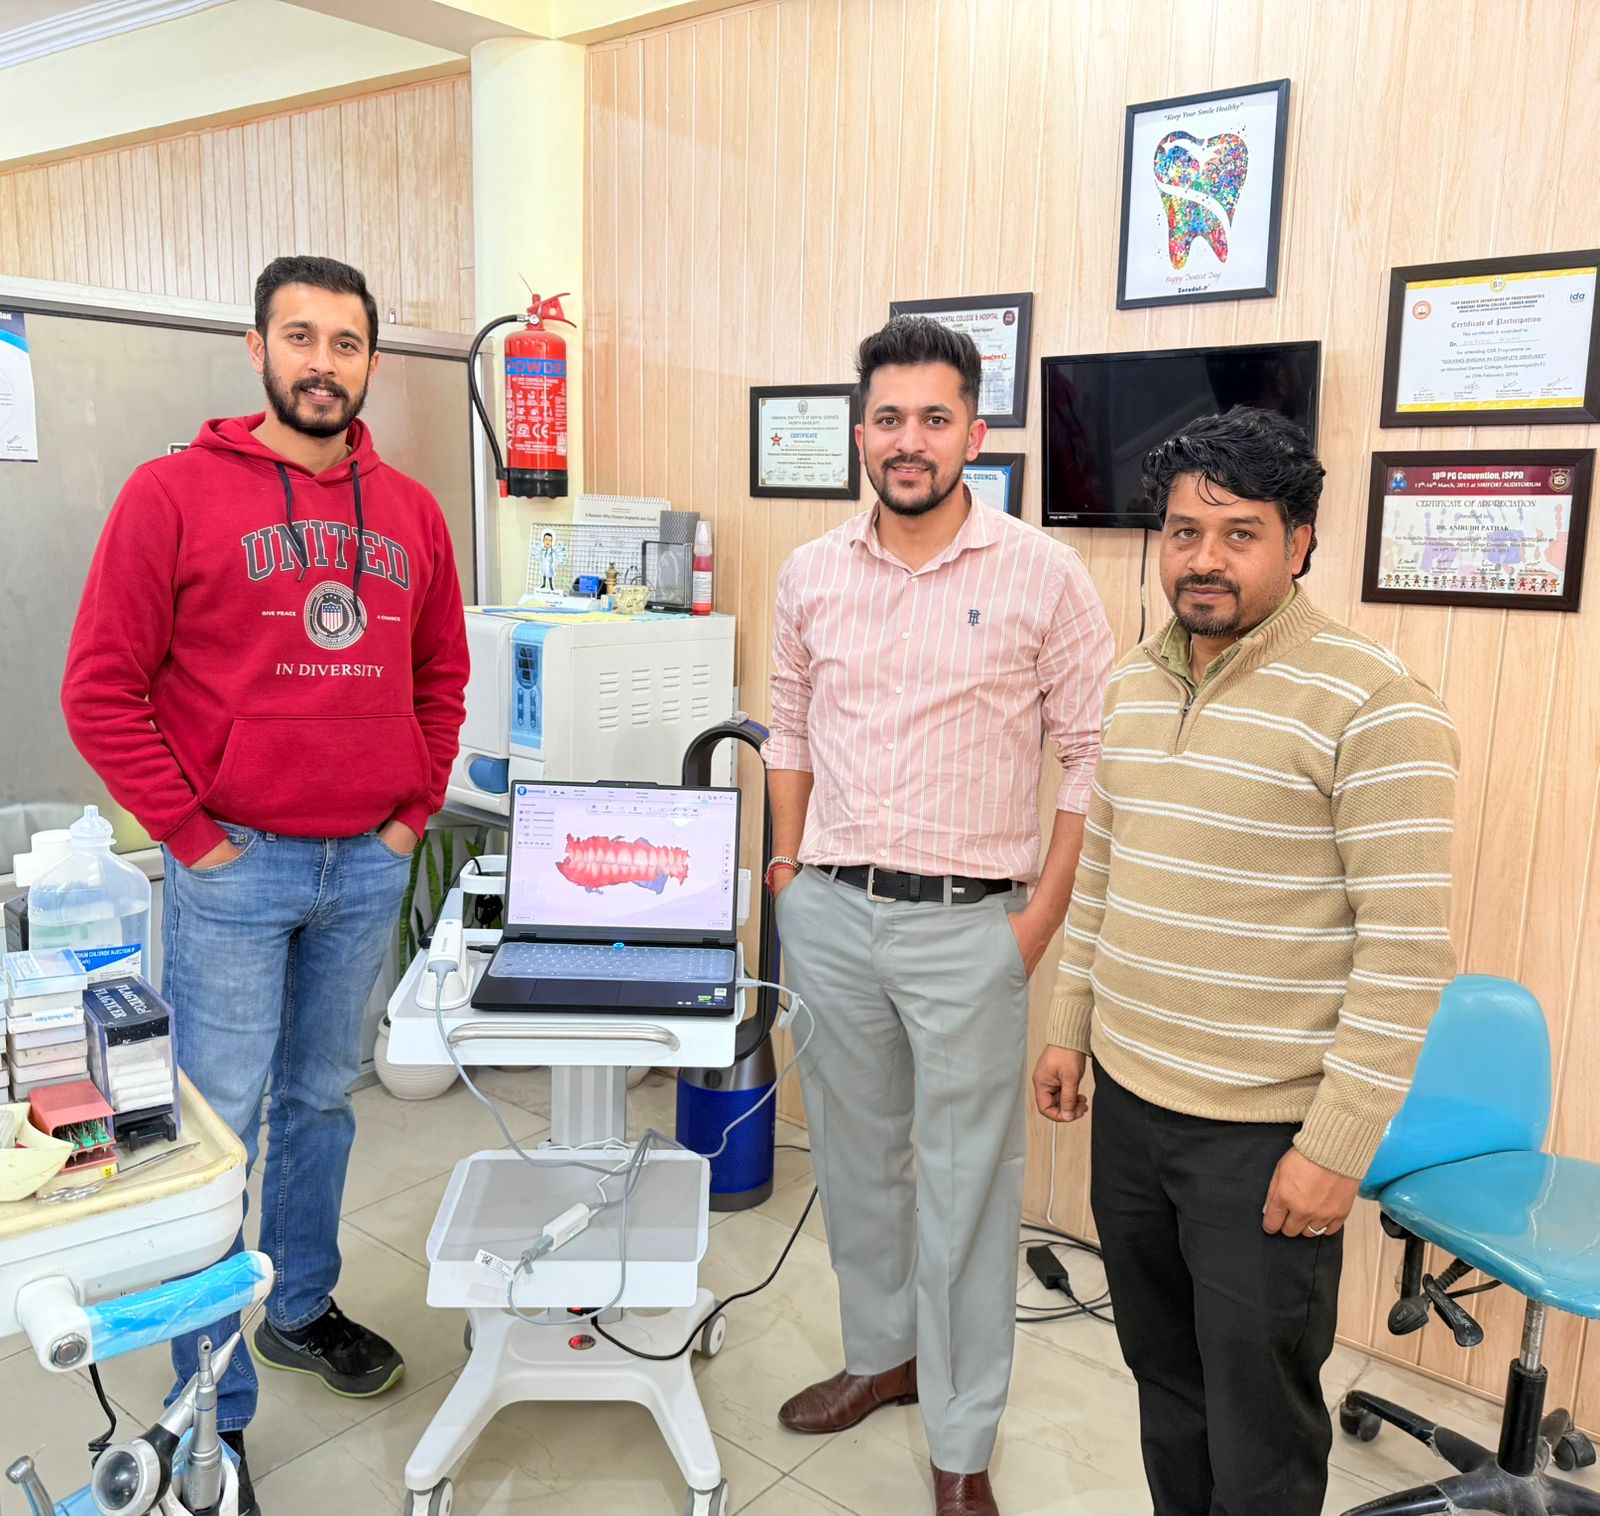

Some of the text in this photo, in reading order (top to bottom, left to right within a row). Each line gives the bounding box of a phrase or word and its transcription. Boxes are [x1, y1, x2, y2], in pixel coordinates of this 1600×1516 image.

[1198, 107, 1214, 116] Smile
[1496, 317, 1541, 326] Participation
[1458, 472, 1500, 480] Convention,
[1502, 471, 1524, 479] ISPPD
[1478, 500, 1537, 508] APPRECIATION
[241, 519, 411, 591] UNITED
[275, 663, 384, 678] IN DIVERSITY
